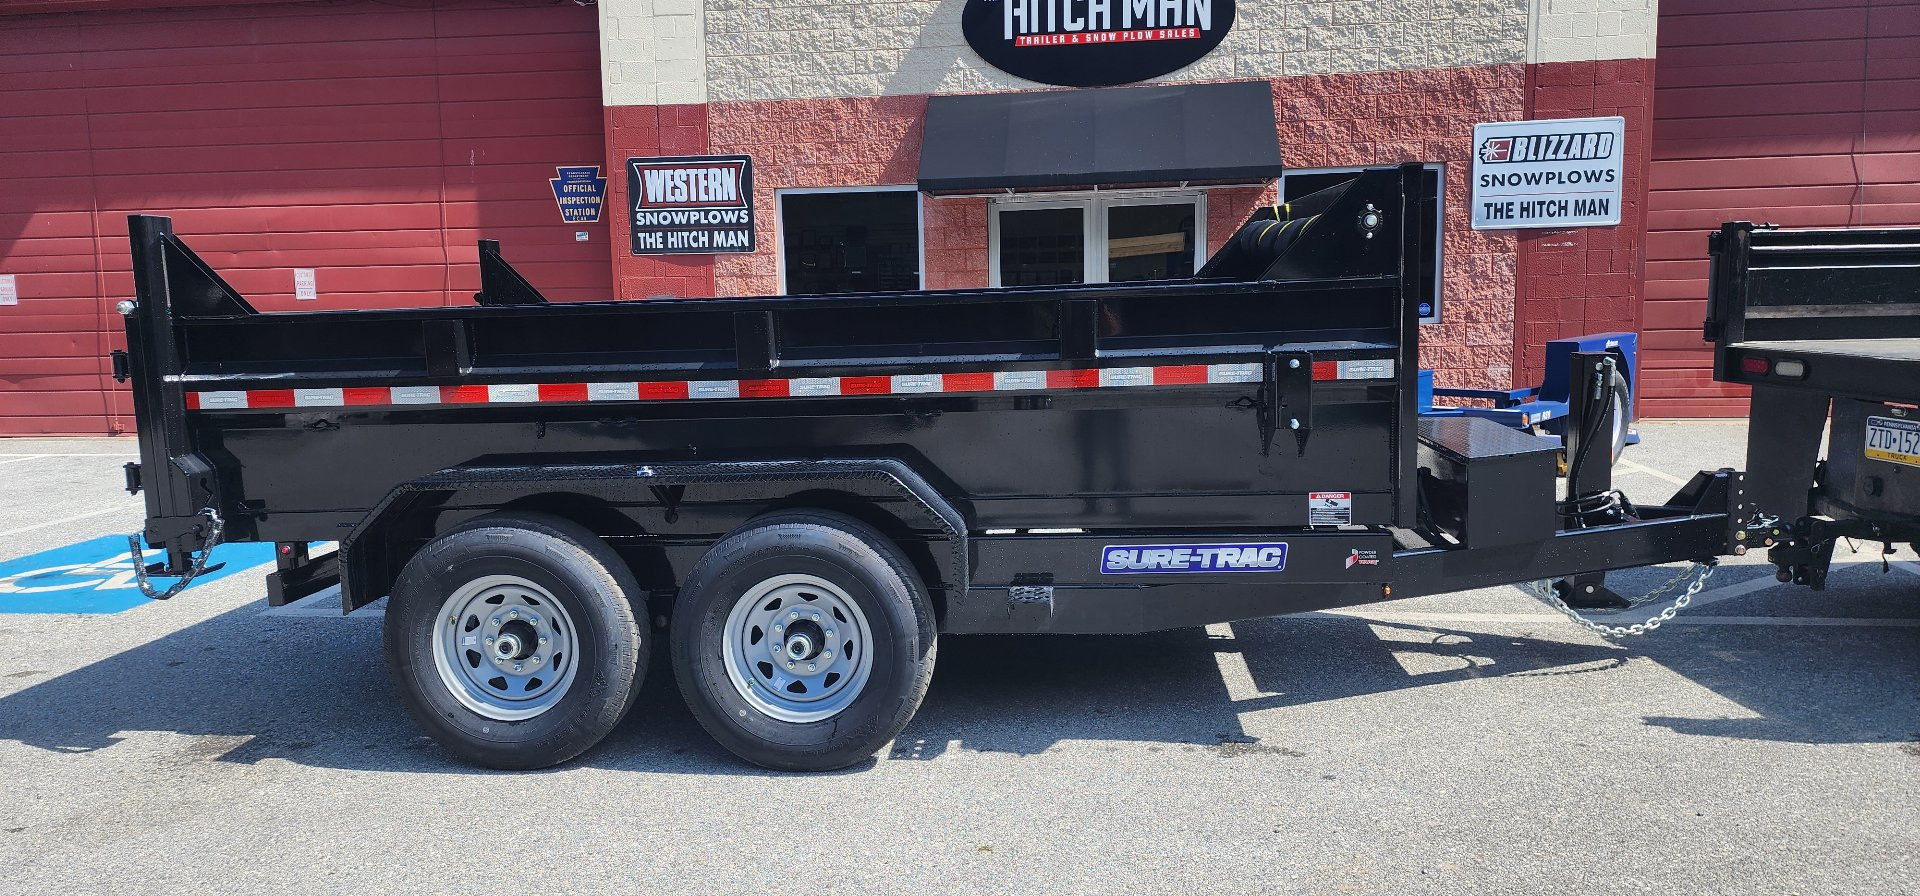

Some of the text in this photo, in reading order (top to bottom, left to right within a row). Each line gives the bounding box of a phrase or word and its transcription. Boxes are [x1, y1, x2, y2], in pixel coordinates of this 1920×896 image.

[1004, 0, 1212, 39] HITCH MAN
[1020, 28, 1195, 45] TRAILER & SNOW PLOW SALES
[1512, 133, 1613, 162] BLIZZARD
[644, 167, 737, 203] WESTERN
[1480, 169, 1615, 188] SNOWPLOWS
[563, 184, 597, 193] OFFICIAL
[560, 196, 600, 205] INSPECTION
[1484, 198, 1610, 220] THE HITCH MAN
[565, 208, 596, 217] STATION
[636, 209, 749, 226] SNOWPLOWS
[638, 230, 749, 249] THE HITCH MAN
[1888, 452, 1907, 461] TRUCK
[1106, 547, 1282, 570] SURE-TRAC
